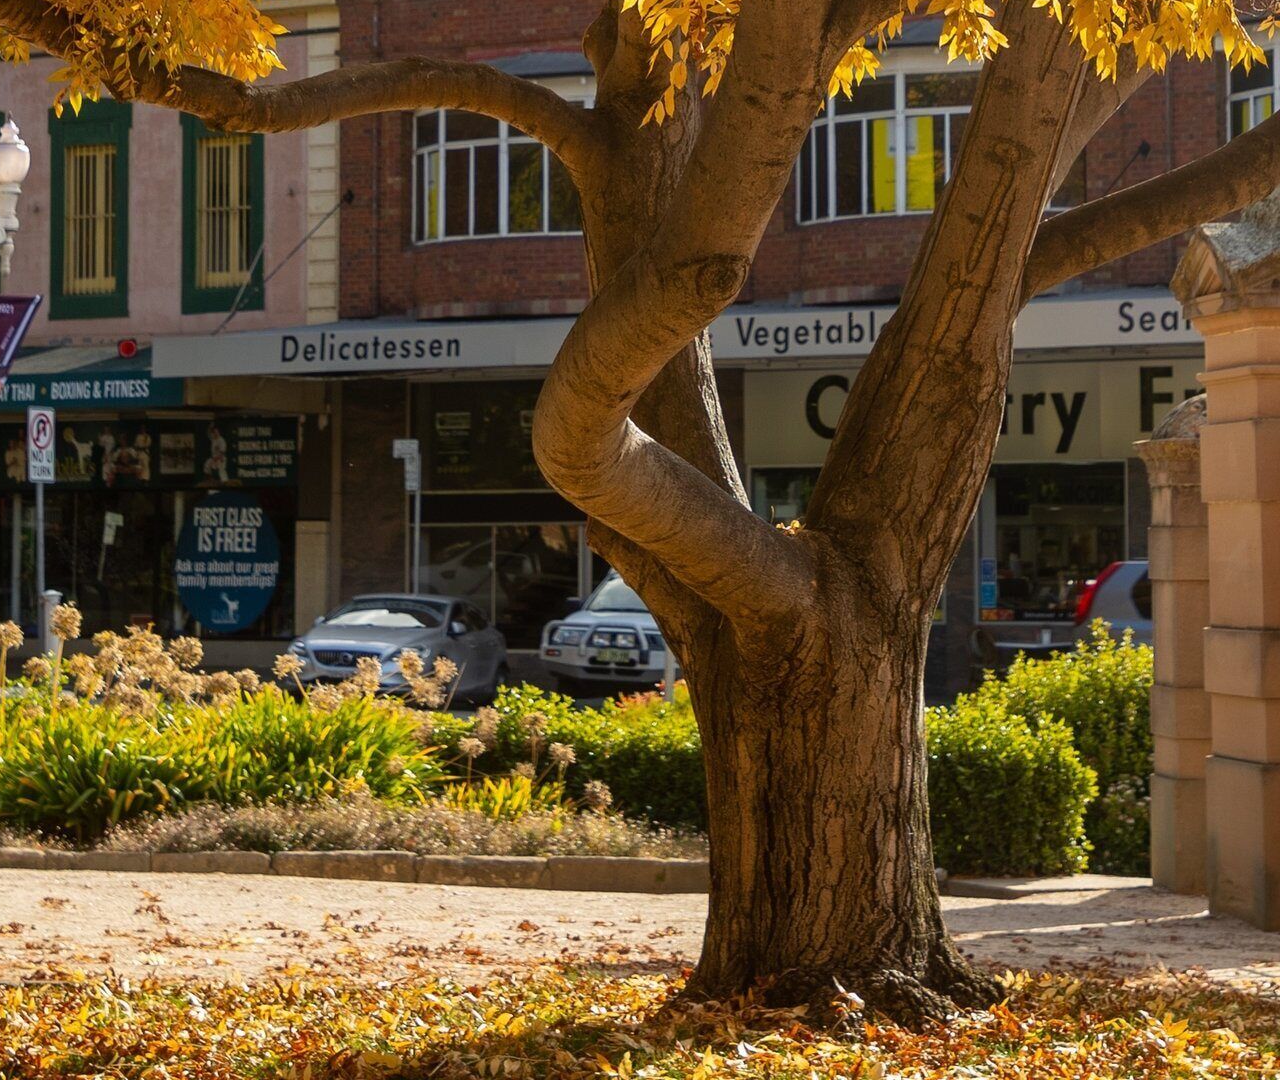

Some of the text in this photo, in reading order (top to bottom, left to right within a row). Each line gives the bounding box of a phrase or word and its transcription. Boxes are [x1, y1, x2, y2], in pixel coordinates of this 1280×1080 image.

[736, 311, 884, 354] Vegetabl
[281, 332, 461, 363] Delicatessen
[12, 383, 35, 401] THAI
[51, 381, 91, 400] BOXING
[92, 381, 102, 399] &
[103, 379, 150, 399] FITNESS
[32, 450, 53, 463] NO U
[32, 465, 51, 476] TURN
[193, 507, 263, 528] FIRST CLASS
[198, 527, 257, 553] IS FREE!
[175, 558, 279, 577] Ask us about our great
[176, 573, 276, 590] family memberships!
